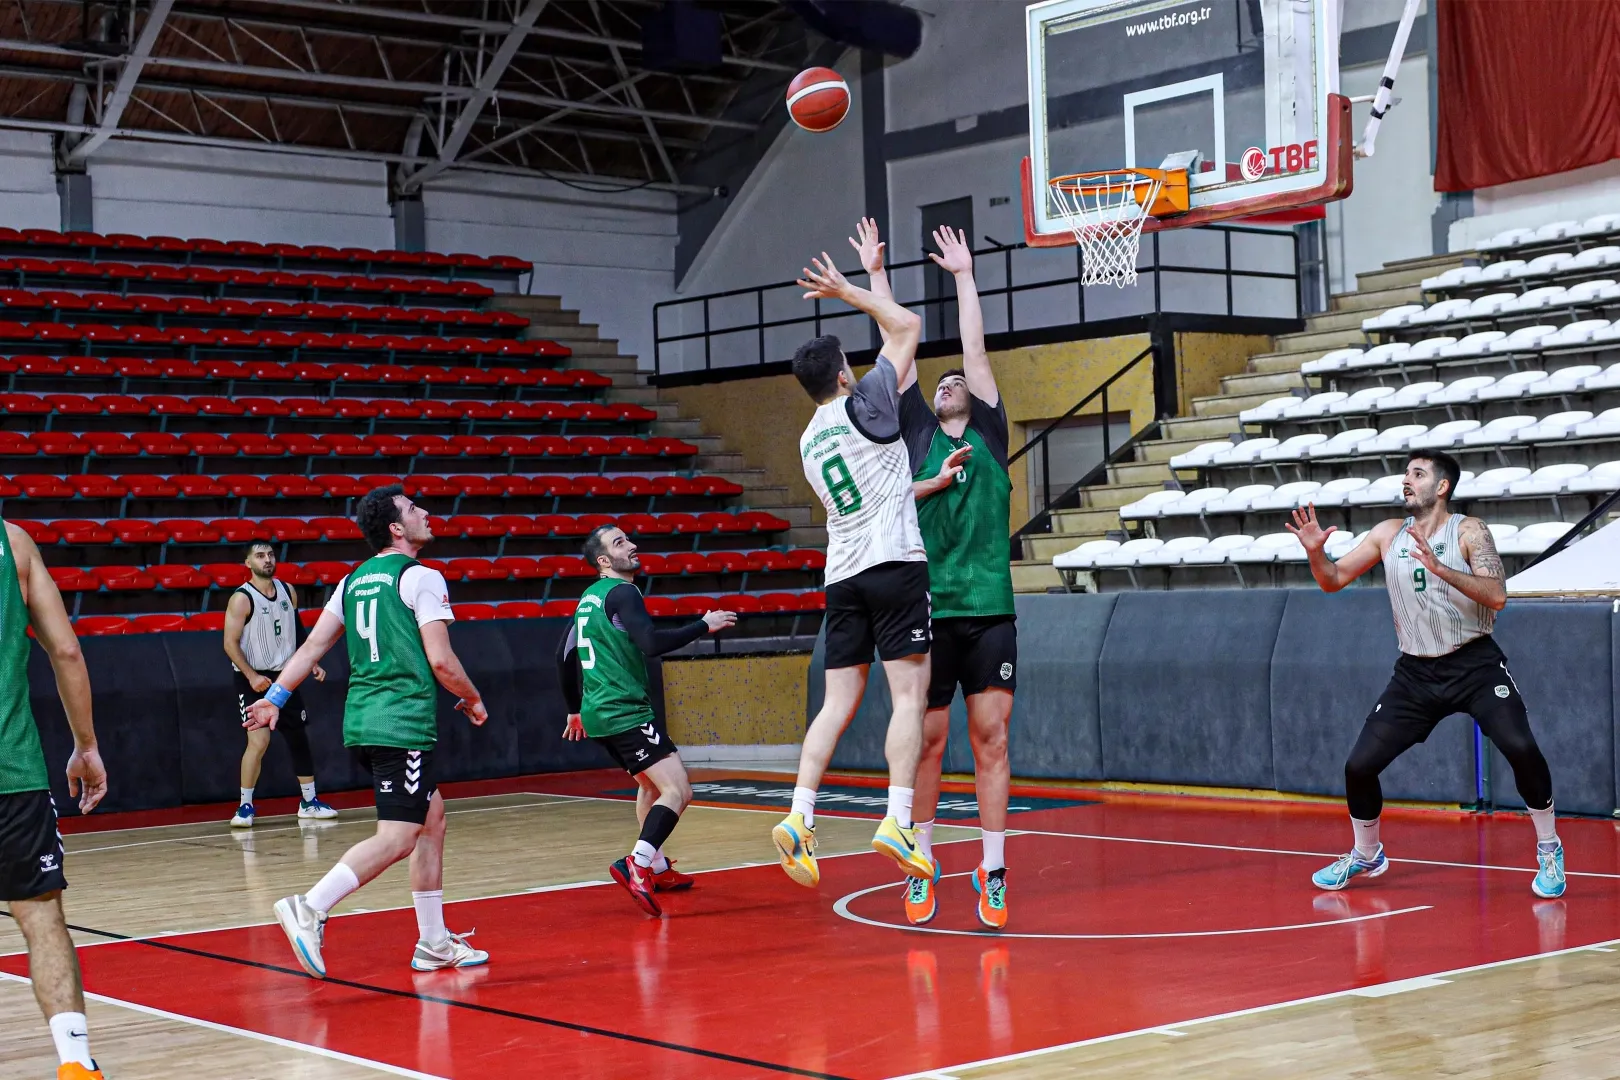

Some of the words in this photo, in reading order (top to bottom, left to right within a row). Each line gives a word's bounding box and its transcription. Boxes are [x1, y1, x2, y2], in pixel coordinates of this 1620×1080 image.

[1126, 6, 1212, 37] www.tbf.org.tr
[1268, 140, 1318, 174] TBF
[821, 453, 863, 517] 8
[1413, 567, 1427, 593] 9
[274, 619, 281, 636] 6
[355, 597, 380, 663] 4
[577, 616, 596, 670] 5
